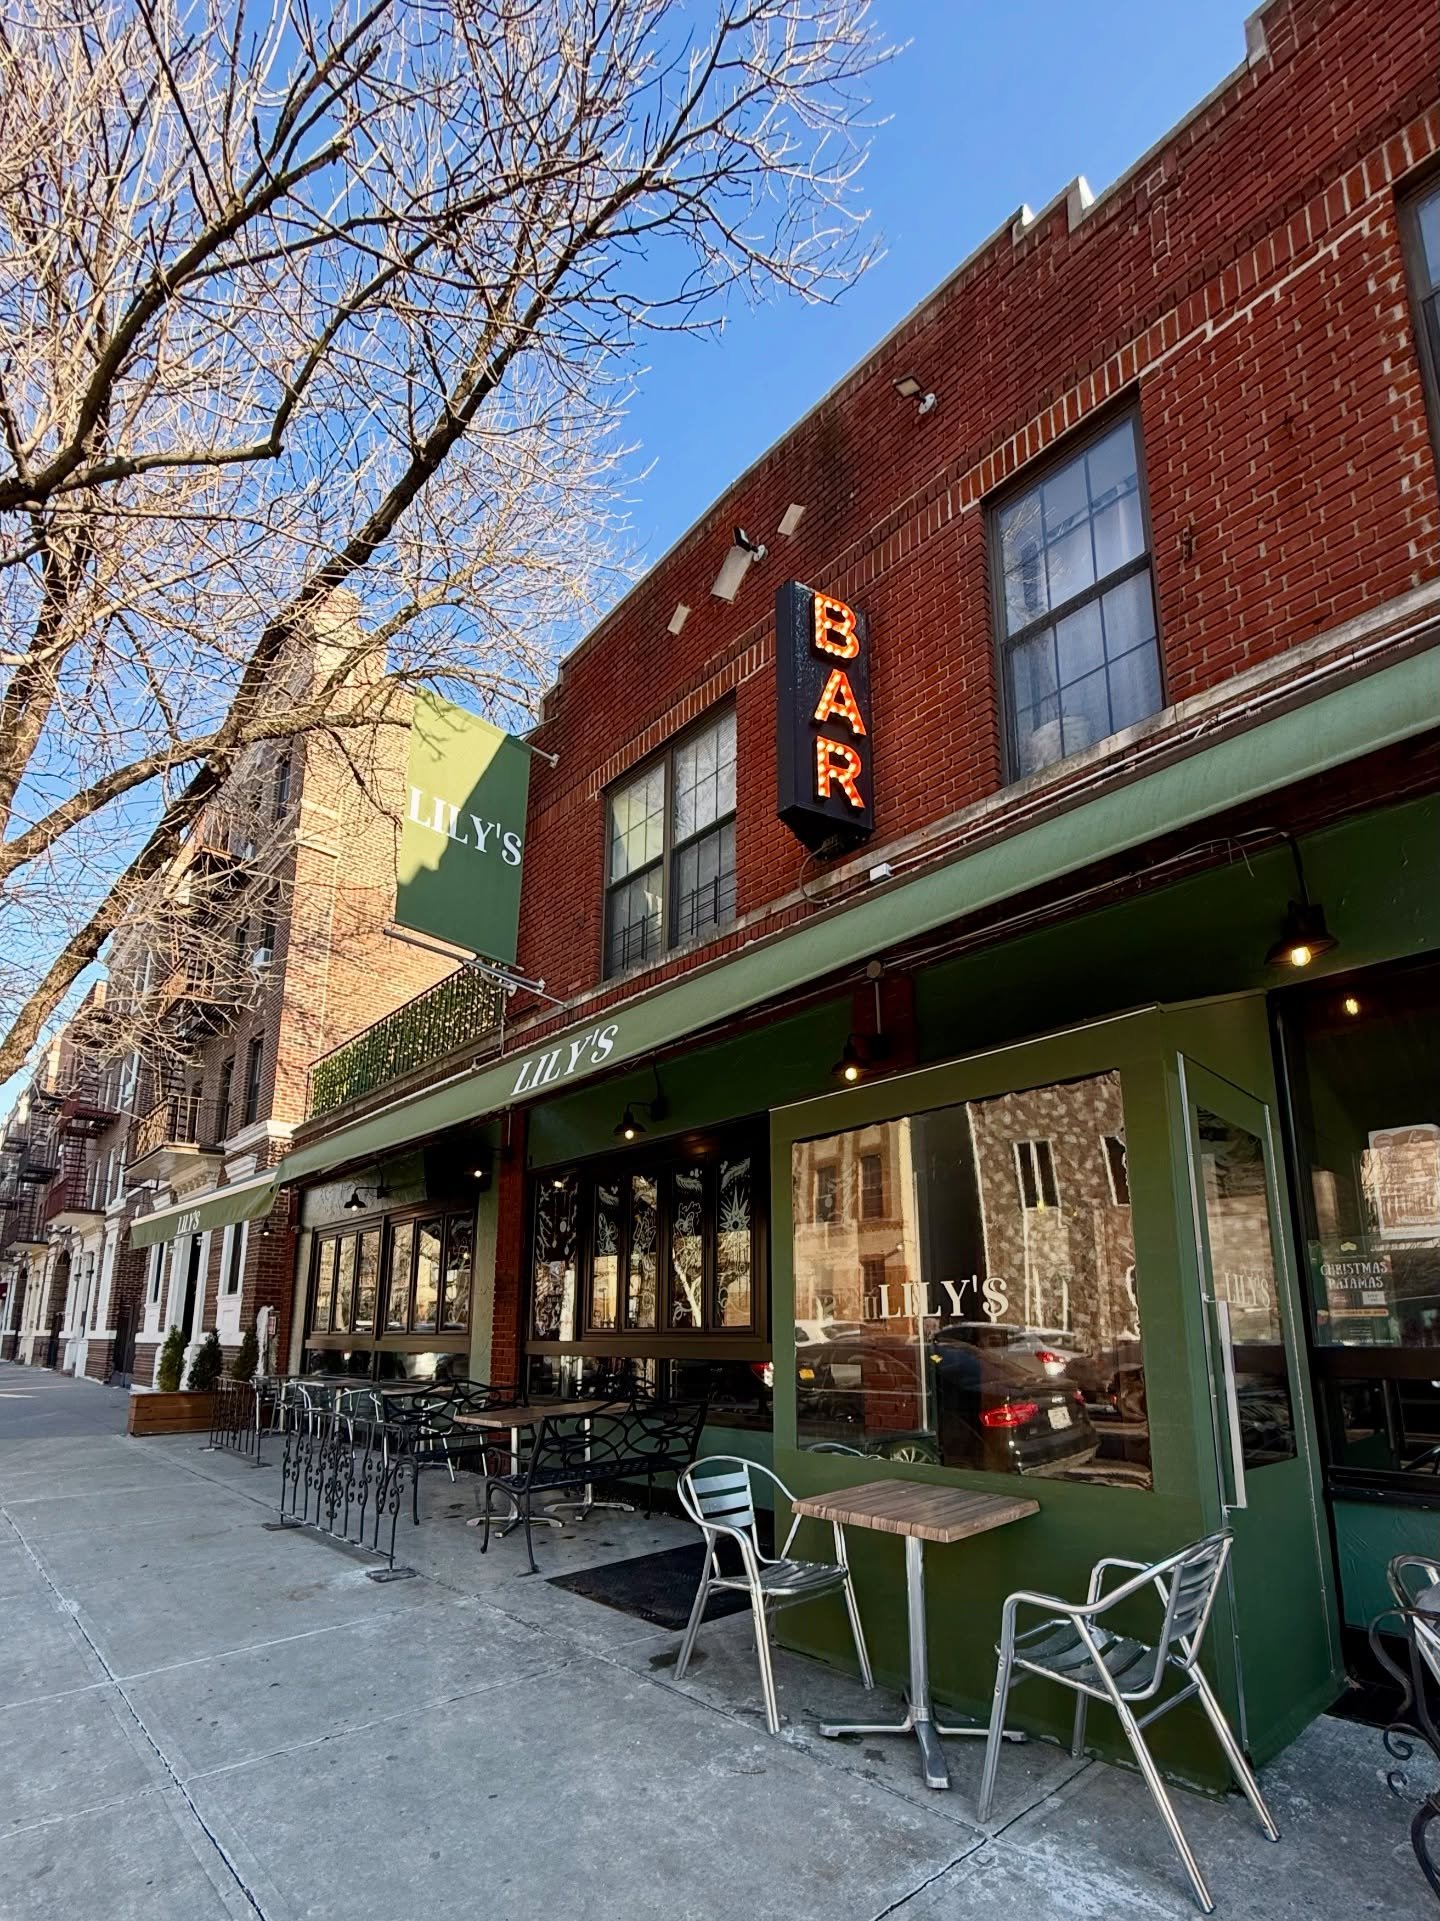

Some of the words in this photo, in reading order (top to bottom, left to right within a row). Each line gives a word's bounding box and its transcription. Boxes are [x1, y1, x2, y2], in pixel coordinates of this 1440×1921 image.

[814, 591, 867, 809] BAR
[407, 785, 522, 866] LILY'S
[510, 1024, 618, 1096] LILY'S
[176, 1210, 200, 1234] LILY'S
[1320, 1261, 1388, 1276] CHRISTMAS
[1326, 1276, 1384, 1290] PAJAMAS
[878, 1274, 1009, 1318] LILY'S
[1224, 1271, 1270, 1308] LILY'S
